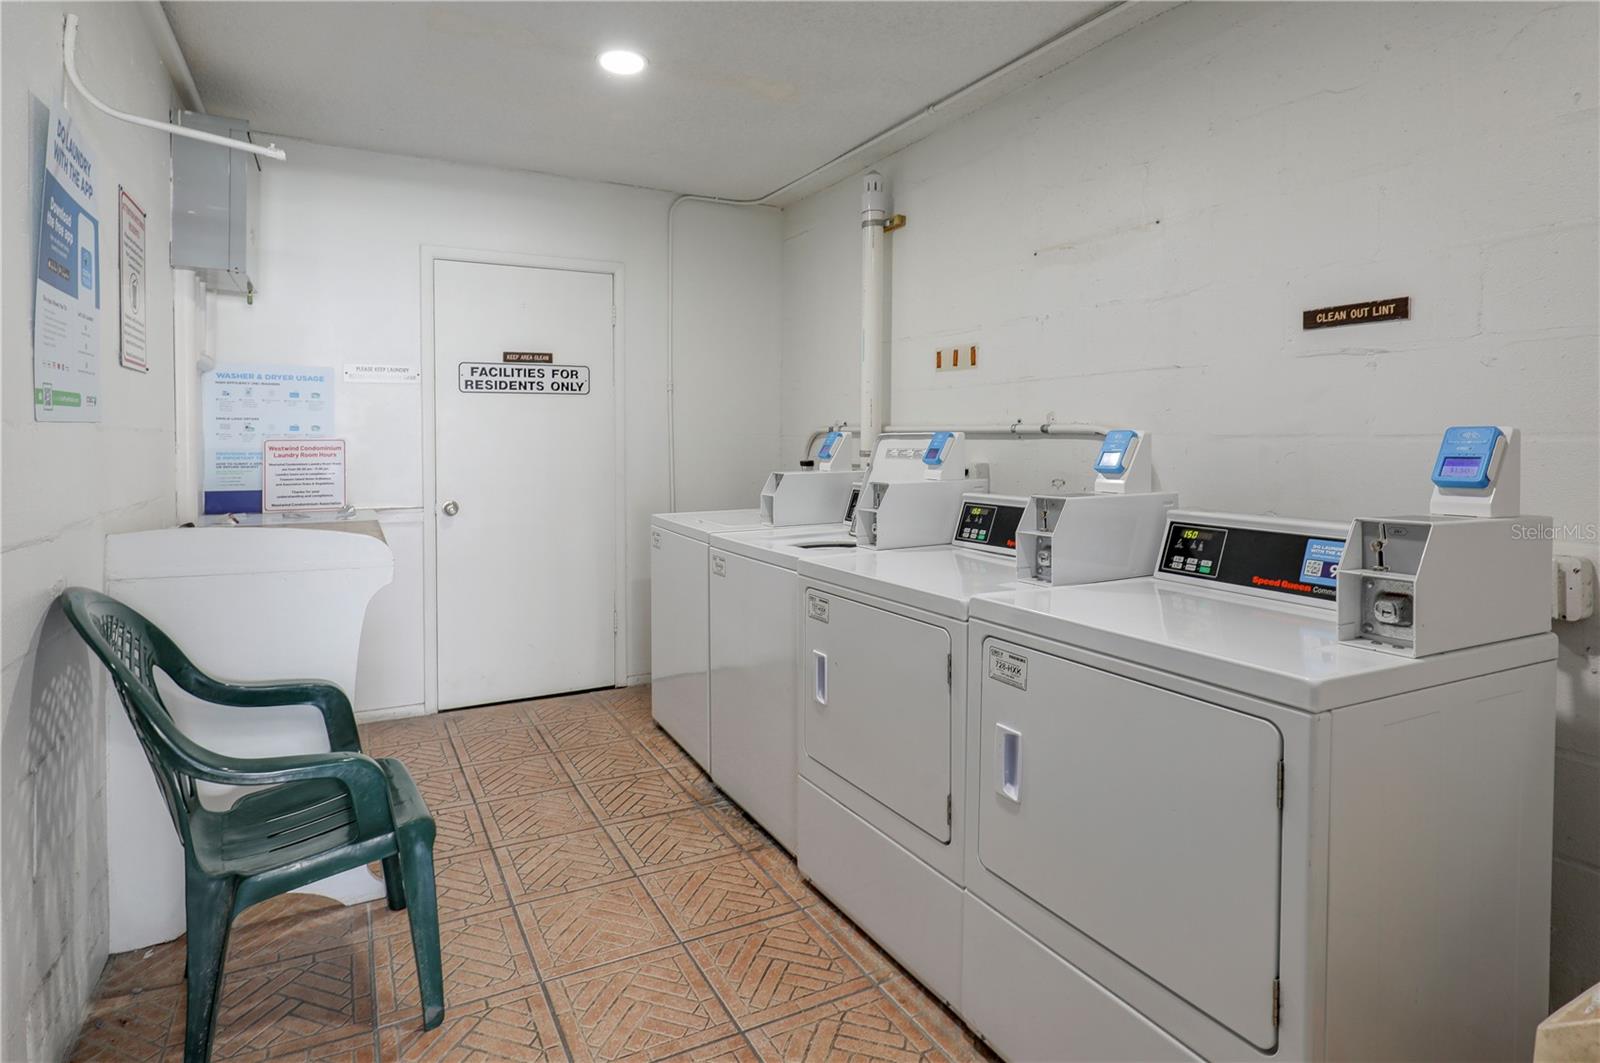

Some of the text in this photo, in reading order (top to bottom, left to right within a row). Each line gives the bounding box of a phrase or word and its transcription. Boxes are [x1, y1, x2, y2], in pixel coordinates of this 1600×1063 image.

[66, 131, 91, 177] LAUNDRY
[54, 140, 93, 200] WITH THE APP
[1316, 304, 1396, 323] CLEAN OUT LINT
[215, 372, 255, 380] WASHER
[470, 366, 579, 379] FACILITIES FOR
[464, 380, 584, 392] RESIDENTS ONLY
[1252, 575, 1280, 586] Speed
[1281, 580, 1312, 592] Queen
